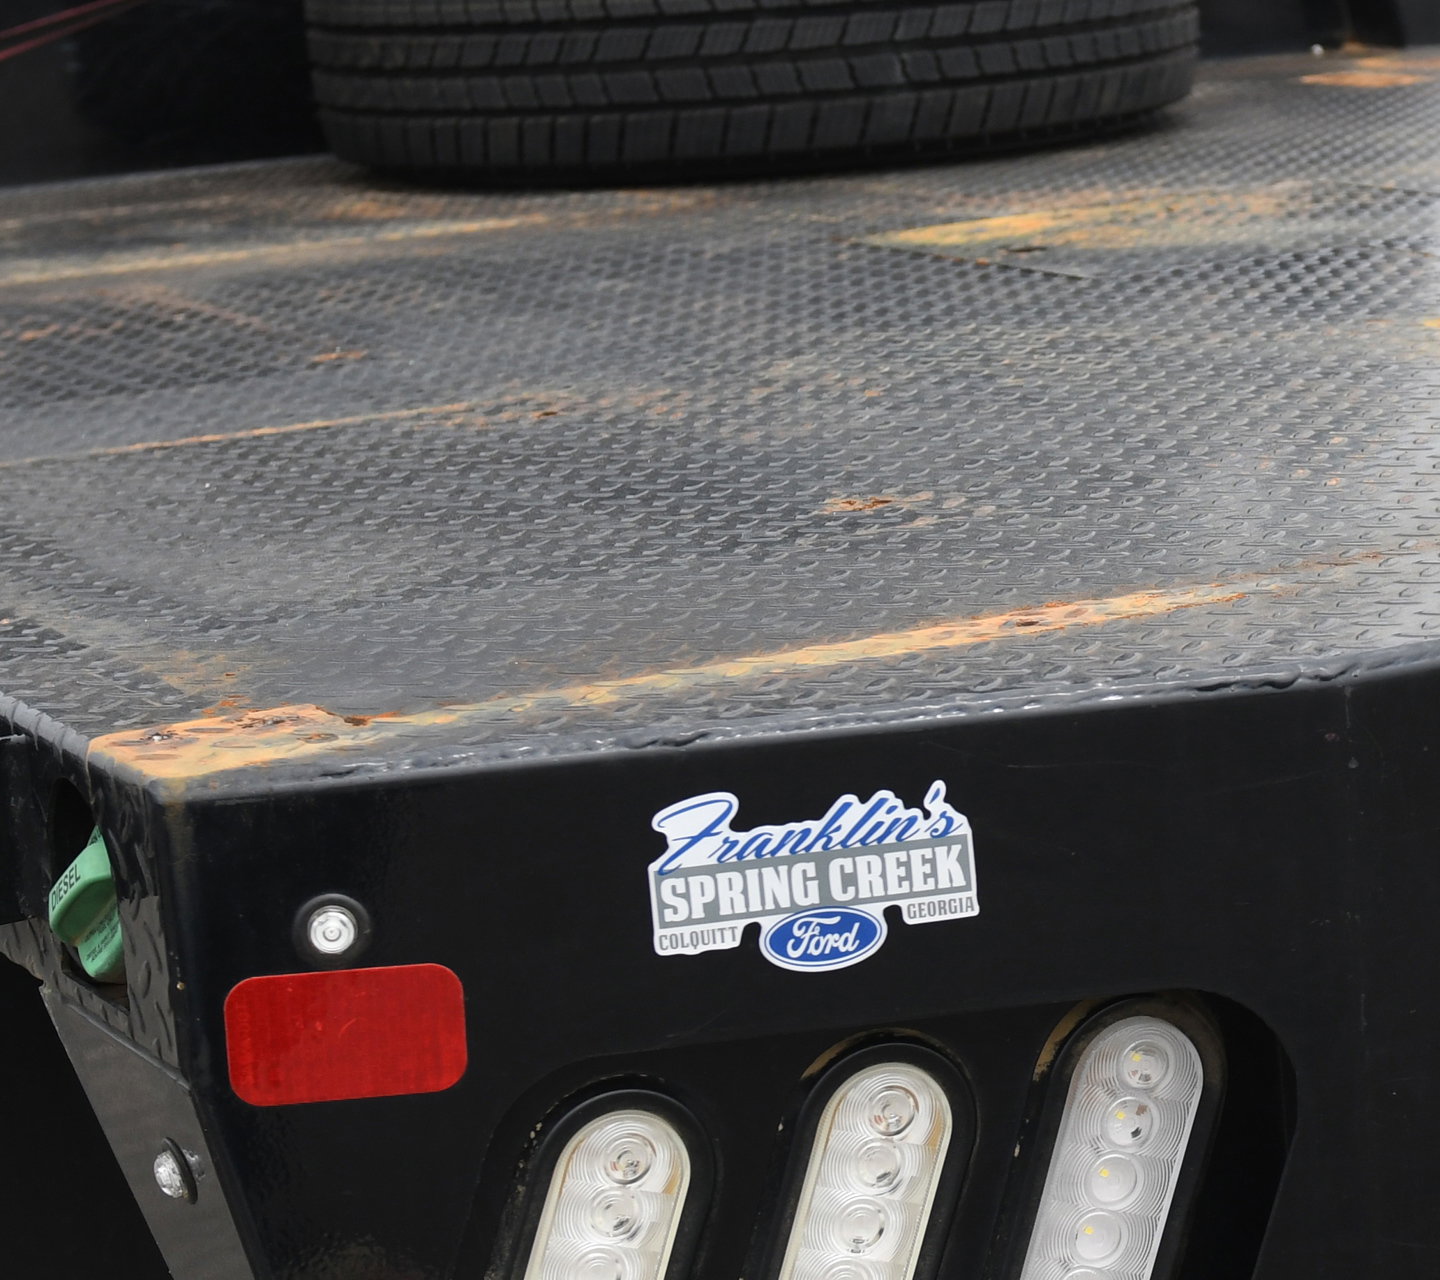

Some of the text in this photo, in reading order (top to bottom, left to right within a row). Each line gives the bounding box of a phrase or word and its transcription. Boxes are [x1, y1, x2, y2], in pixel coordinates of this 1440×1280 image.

[657, 788, 964, 876] Franklin's
[51, 863, 81, 912] DIESEL
[661, 843, 966, 923] SPRING CREEK
[659, 896, 975, 959] COLQUITT Ford GEORGIA
